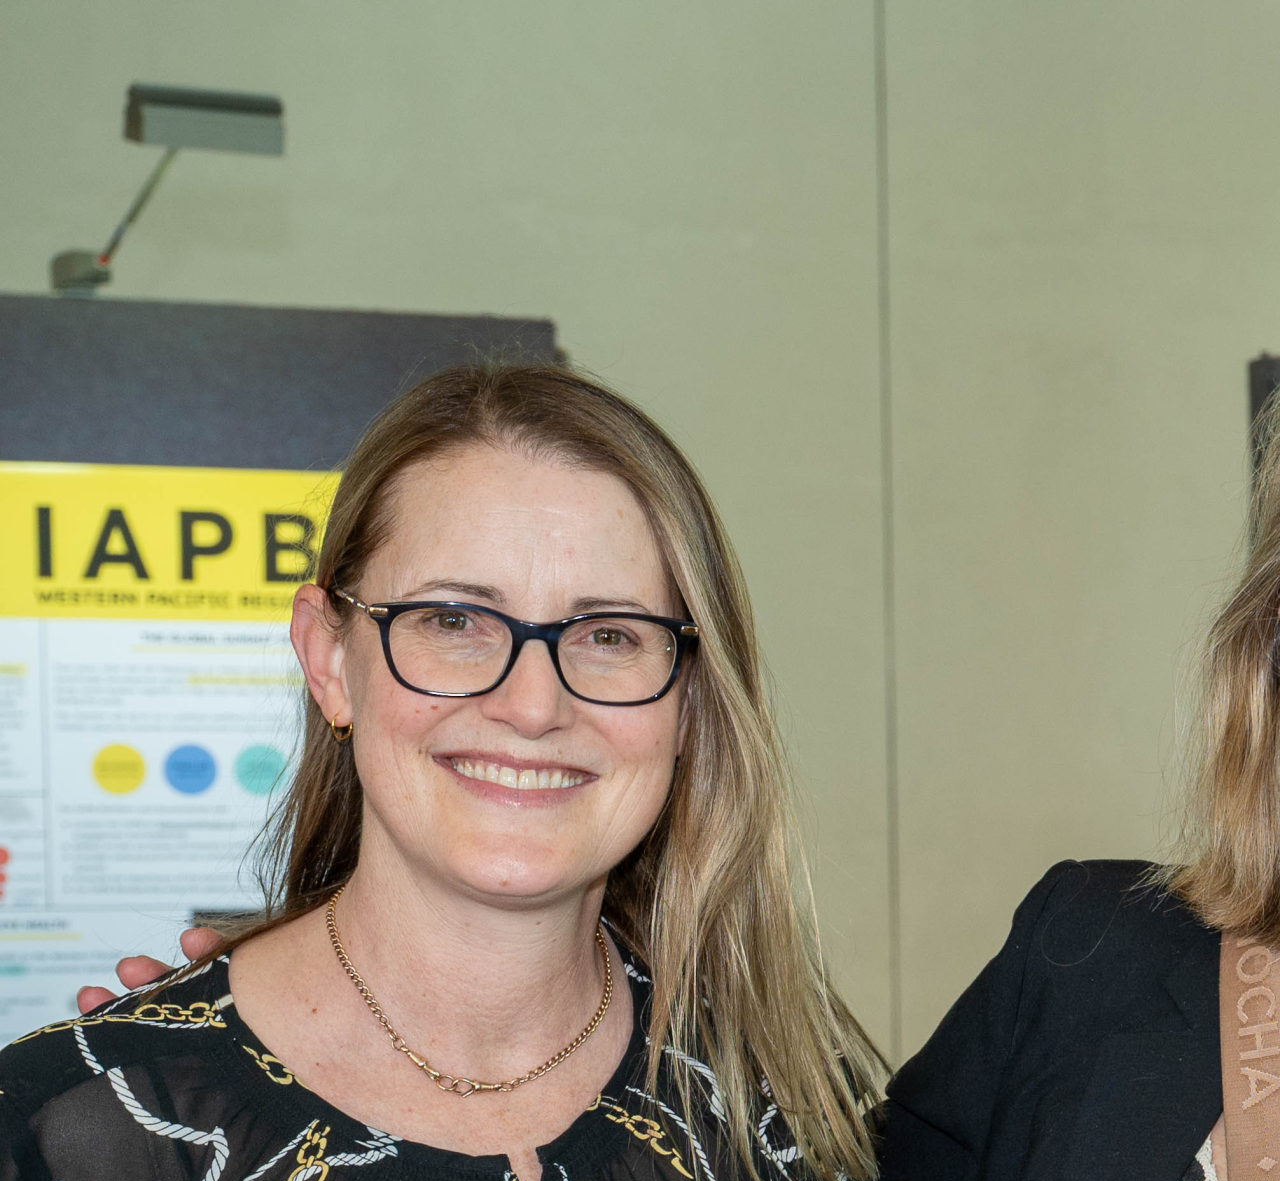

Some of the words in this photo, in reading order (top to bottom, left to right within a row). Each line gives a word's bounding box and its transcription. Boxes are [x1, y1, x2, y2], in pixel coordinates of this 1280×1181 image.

[36, 506, 316, 583] IAPB
[36, 589, 138, 606] WESTERN
[238, 591, 293, 608] REGI
